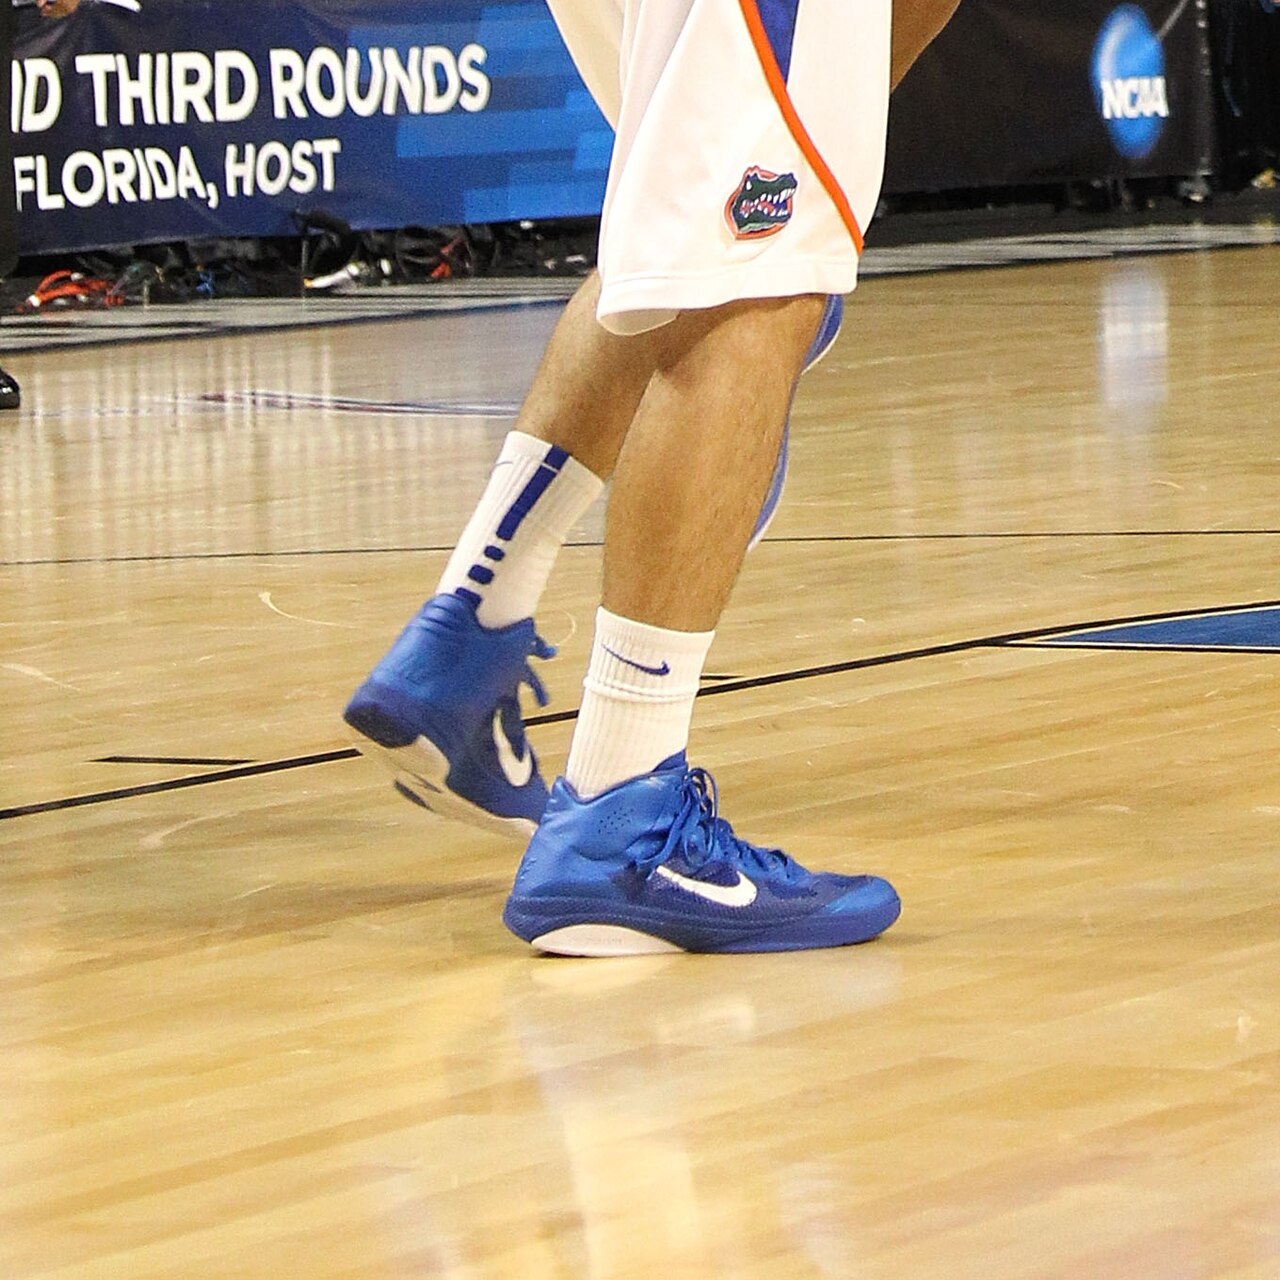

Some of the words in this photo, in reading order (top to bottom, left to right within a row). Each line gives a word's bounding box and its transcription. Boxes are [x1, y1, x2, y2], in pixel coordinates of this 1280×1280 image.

[75, 49, 259, 127] THIRD
[269, 43, 492, 120] ROUNDS
[1100, 75, 1169, 120] NCAA
[14, 145, 219, 210] FLORIDA,
[225, 138, 341, 197] HOST
